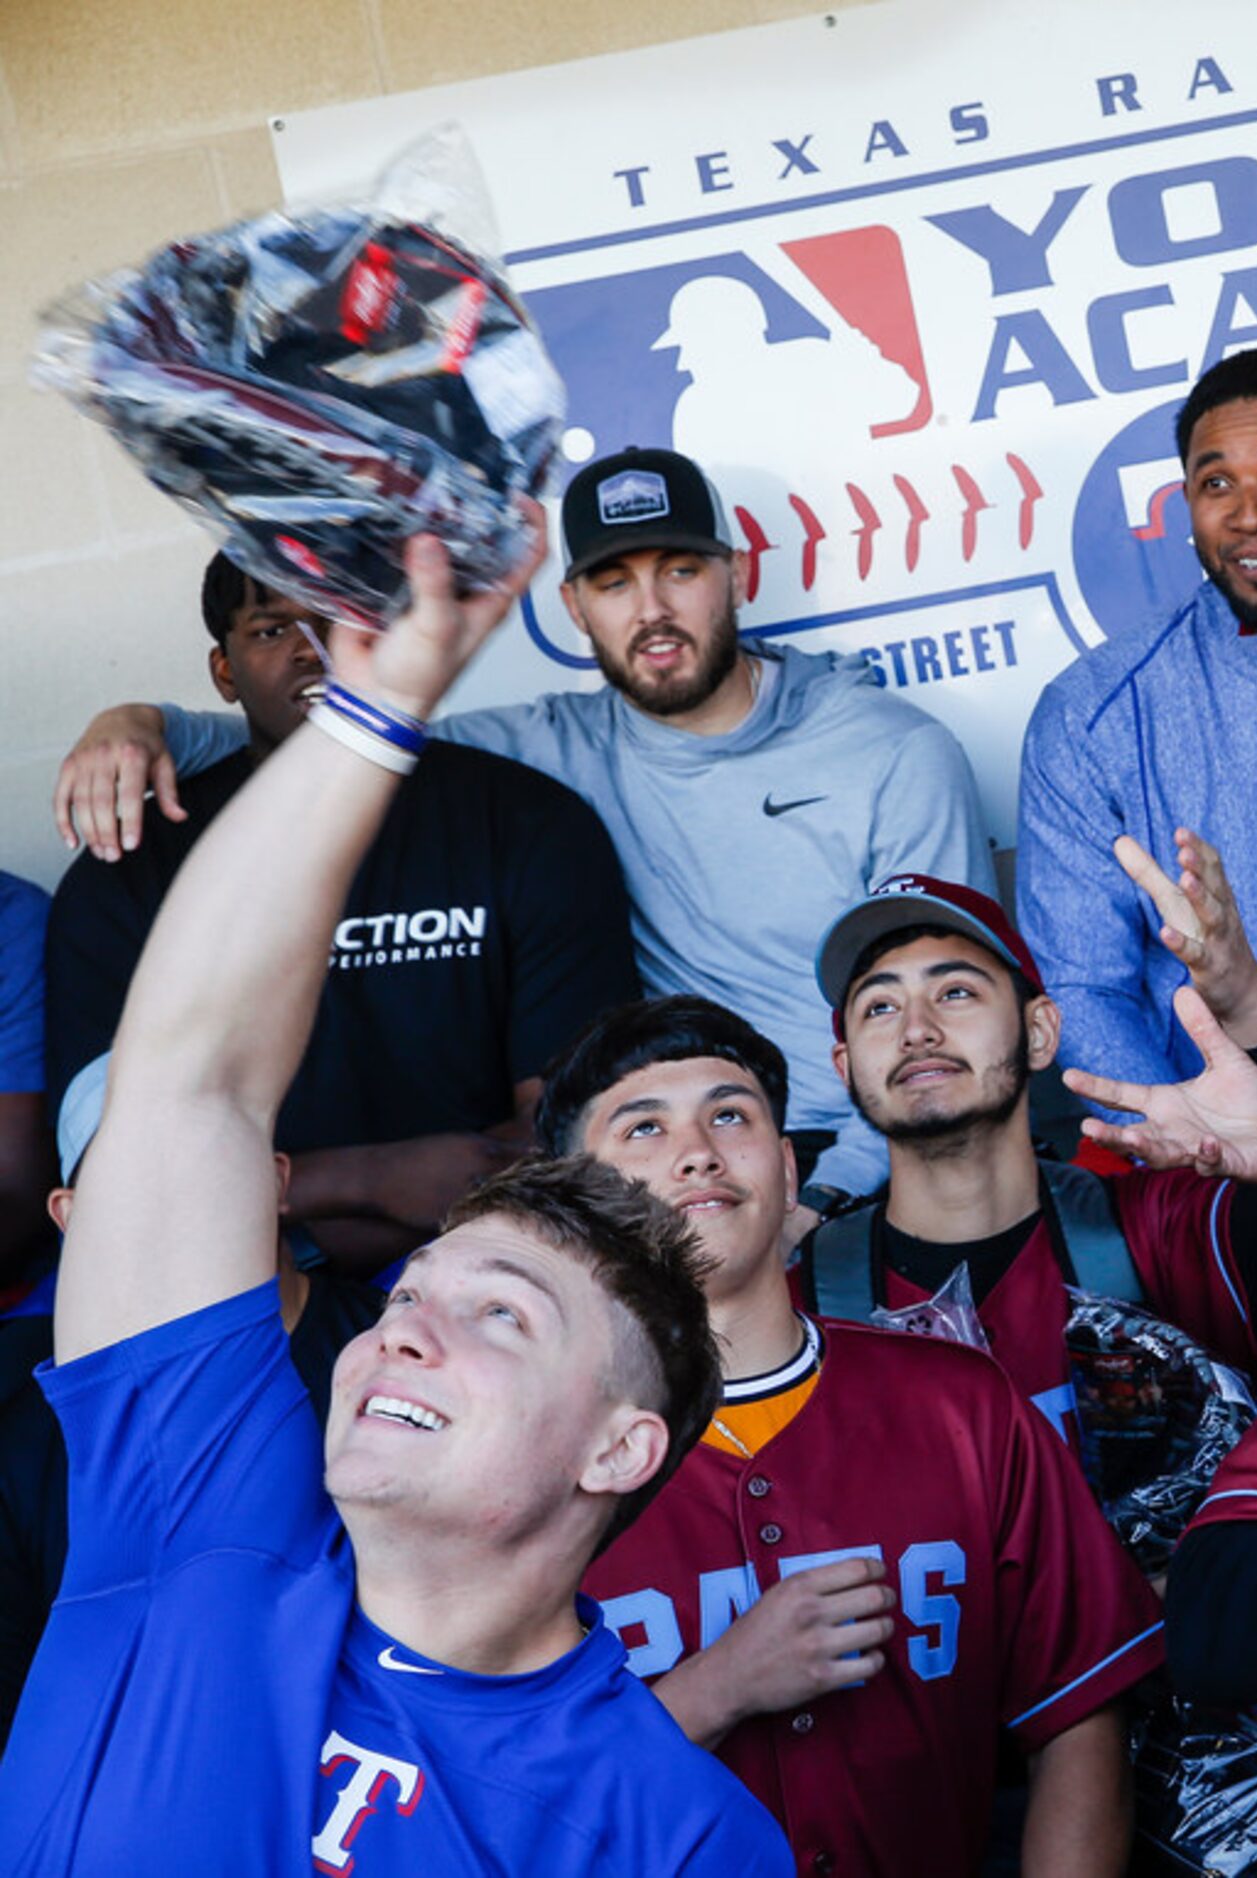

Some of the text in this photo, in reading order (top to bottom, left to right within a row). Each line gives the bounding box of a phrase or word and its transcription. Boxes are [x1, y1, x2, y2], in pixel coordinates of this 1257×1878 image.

[613, 102, 990, 208] TEXAS
[860, 620, 1018, 689] STREET
[331, 907, 486, 951] CTION
[311, 1729, 425, 1878] T
